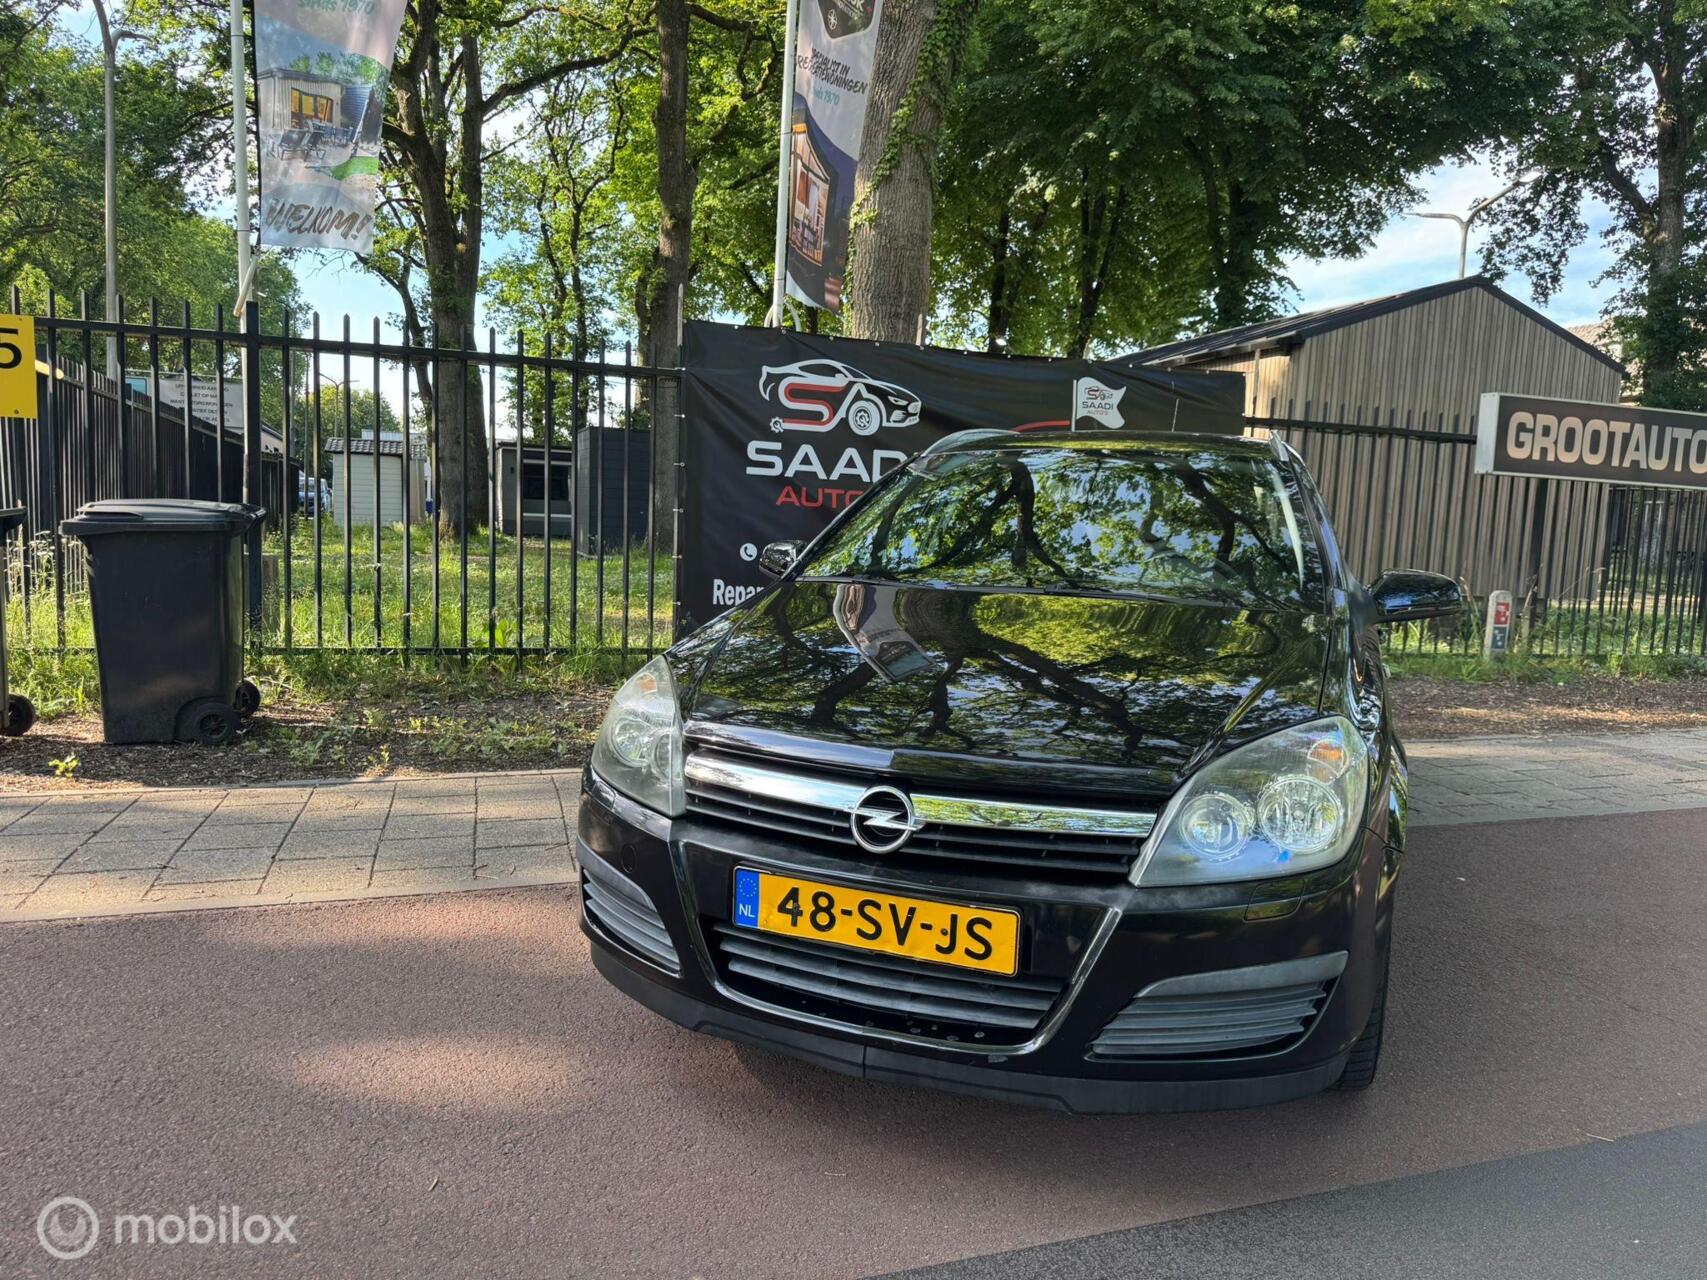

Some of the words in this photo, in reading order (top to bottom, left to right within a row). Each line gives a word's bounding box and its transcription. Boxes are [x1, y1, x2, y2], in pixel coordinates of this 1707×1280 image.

[264, 200, 373, 241] WELKOM!
[1082, 401, 1114, 411] SAADI
[745, 440, 918, 483] SAAD
[1506, 411, 1707, 475] GROOTAUTO
[738, 903, 756, 919] NL
[777, 886, 993, 961] 48-SV-JS
